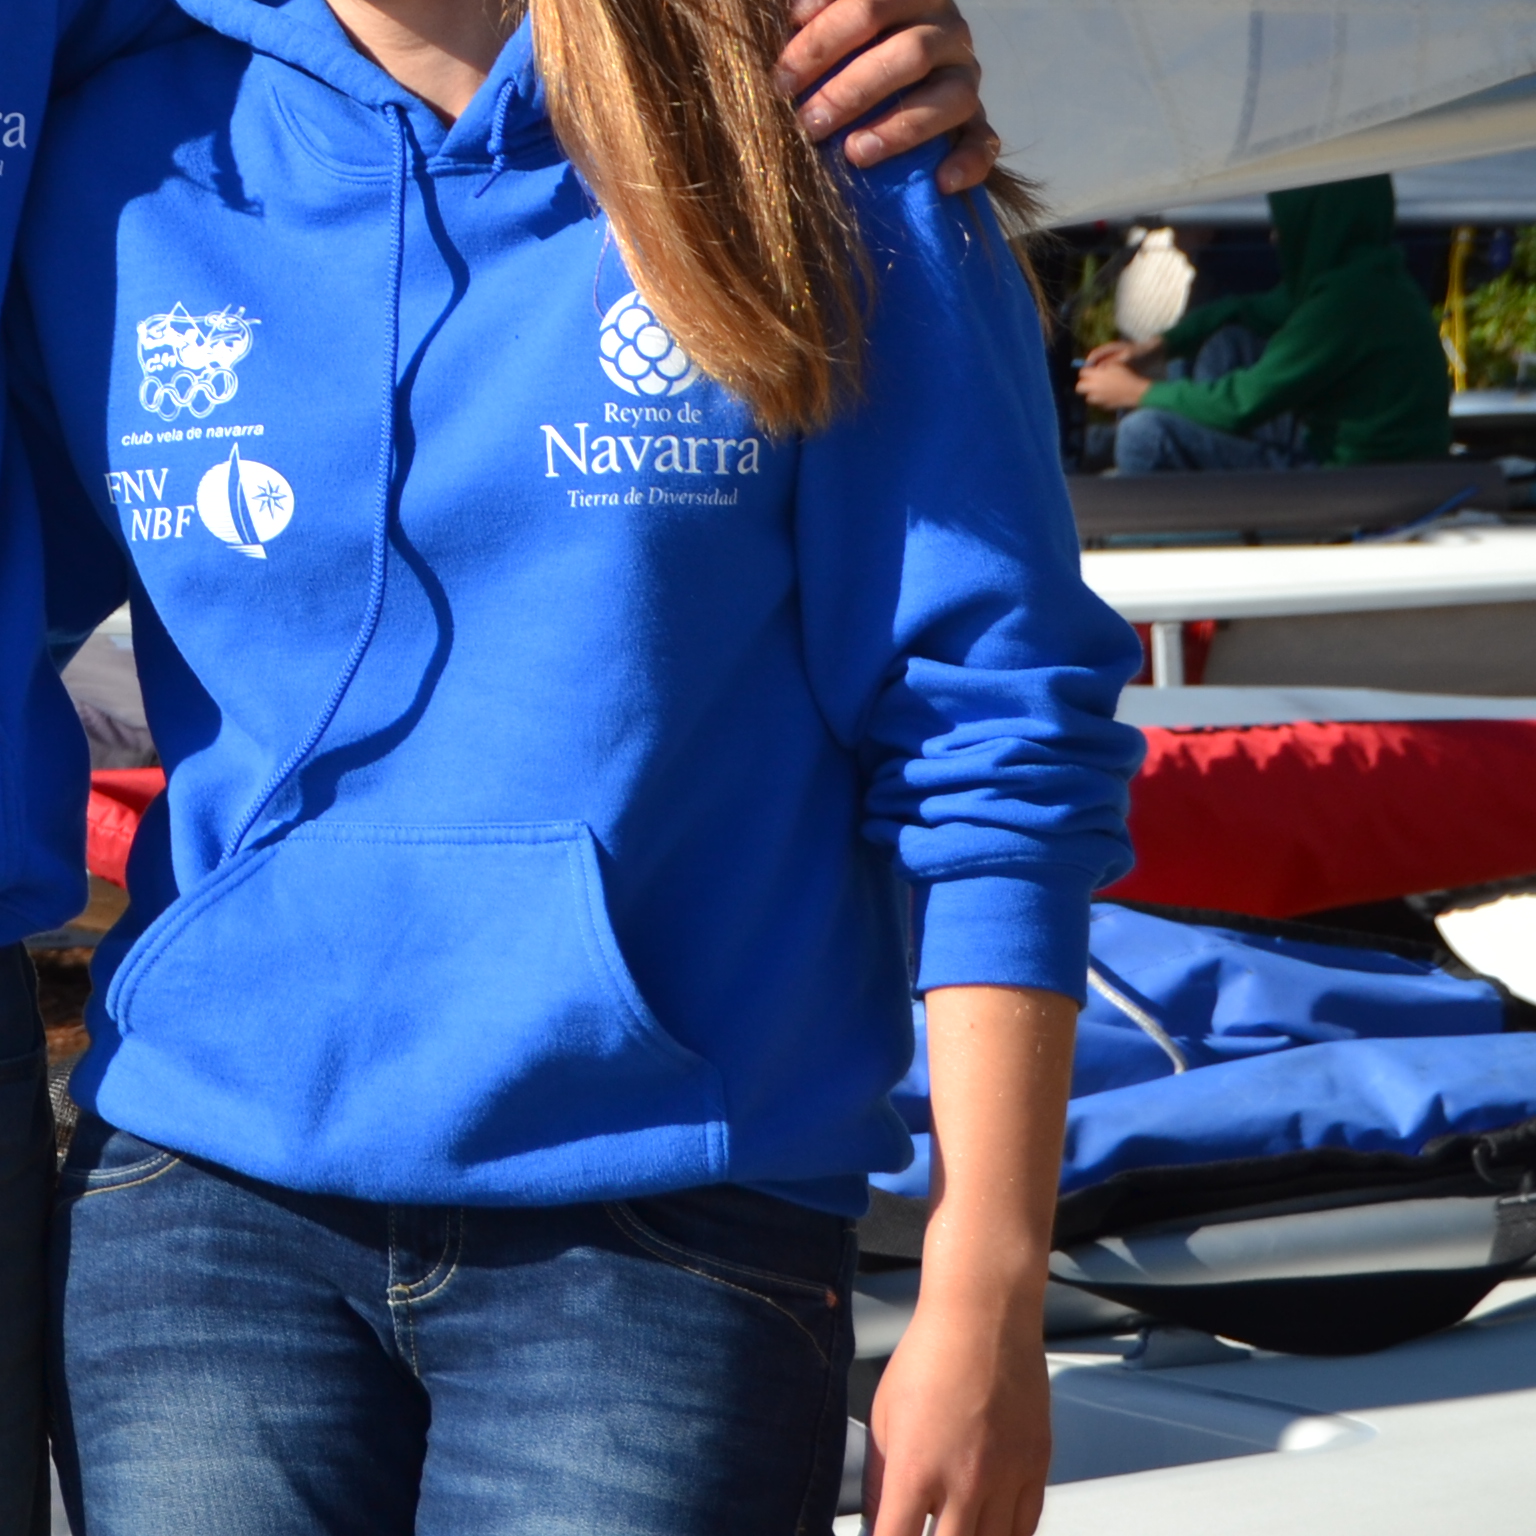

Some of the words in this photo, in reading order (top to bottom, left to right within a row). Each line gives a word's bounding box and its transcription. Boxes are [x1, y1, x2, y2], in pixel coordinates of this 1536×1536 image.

[603, 402, 672, 428] Reyno
[677, 401, 702, 423] de
[121, 430, 153, 447] club
[156, 428, 183, 443] vela
[186, 425, 202, 439] de
[205, 423, 265, 438] navarra
[540, 422, 760, 478] Navarra
[104, 467, 170, 505] FNV
[567, 488, 620, 508] Tierra
[623, 486, 643, 505] de
[648, 487, 739, 506] Diversidad
[131, 504, 195, 542] NBF
